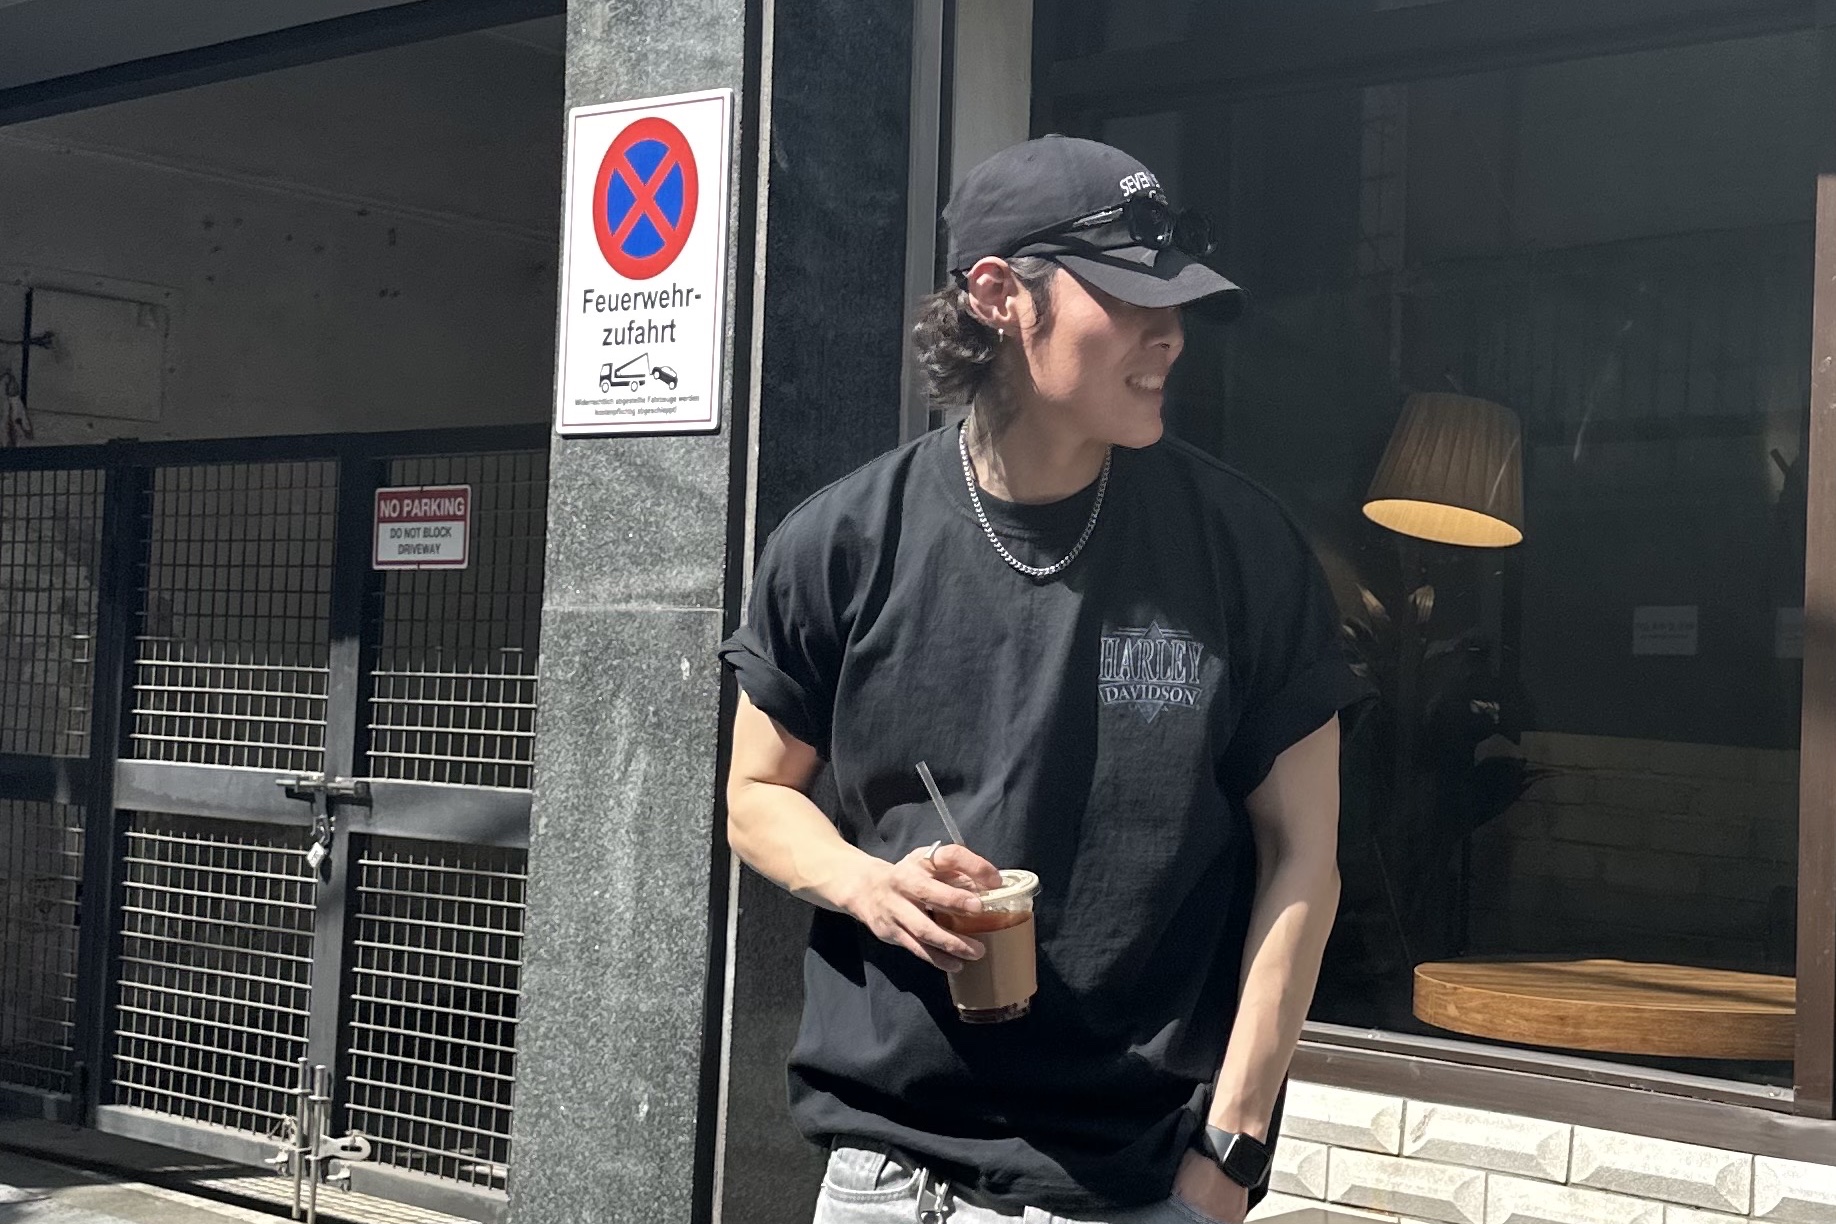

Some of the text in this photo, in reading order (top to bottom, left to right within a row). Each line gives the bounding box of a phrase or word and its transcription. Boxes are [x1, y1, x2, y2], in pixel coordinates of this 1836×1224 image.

[583, 283, 701, 313] Feuerwehr-
[602, 319, 677, 346] zufahrt
[380, 497, 465, 518] NO PARKING
[390, 526, 452, 539] DO NOT BLOCK
[398, 543, 441, 555] DRIVEWAY
[1098, 637, 1204, 684] HARLEY
[1105, 685, 1199, 705] DAVIDSON
